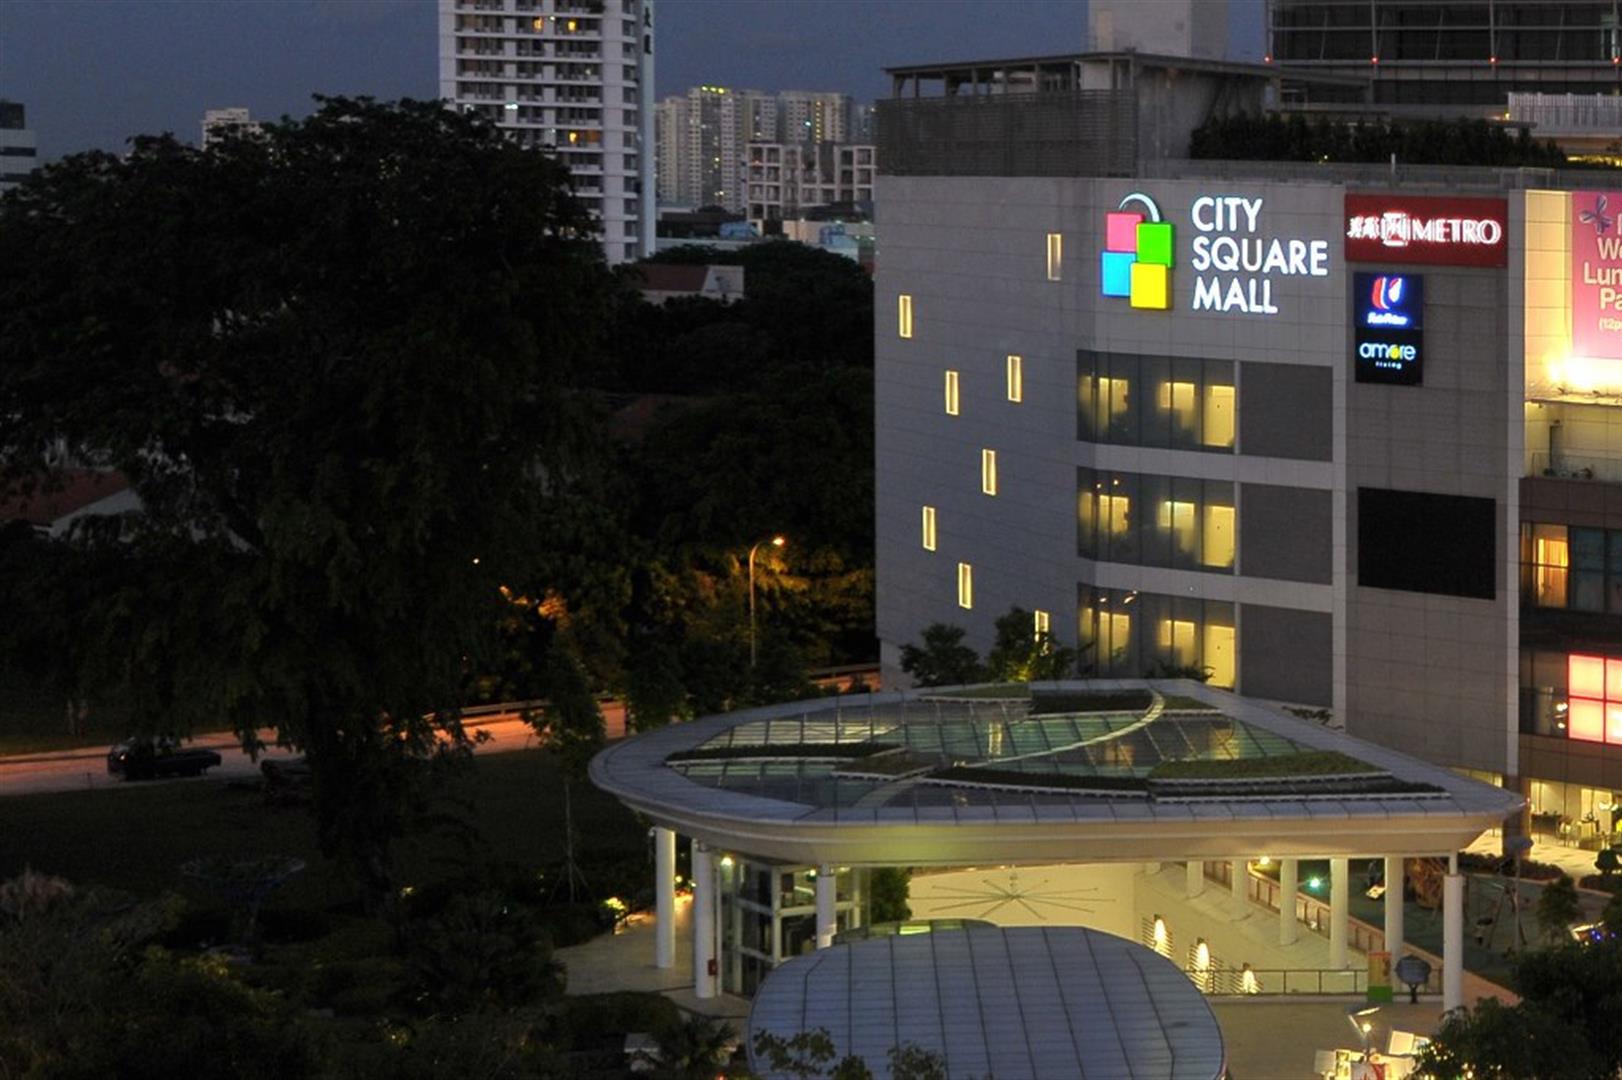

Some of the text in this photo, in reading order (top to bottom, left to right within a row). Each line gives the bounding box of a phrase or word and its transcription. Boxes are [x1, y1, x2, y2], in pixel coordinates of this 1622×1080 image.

[1192, 196, 1263, 232] CITY
[1412, 218, 1502, 244] METRO
[1192, 236, 1328, 275] SQUARE
[1192, 276, 1278, 313] MALL
[1360, 342, 1416, 360] amore
